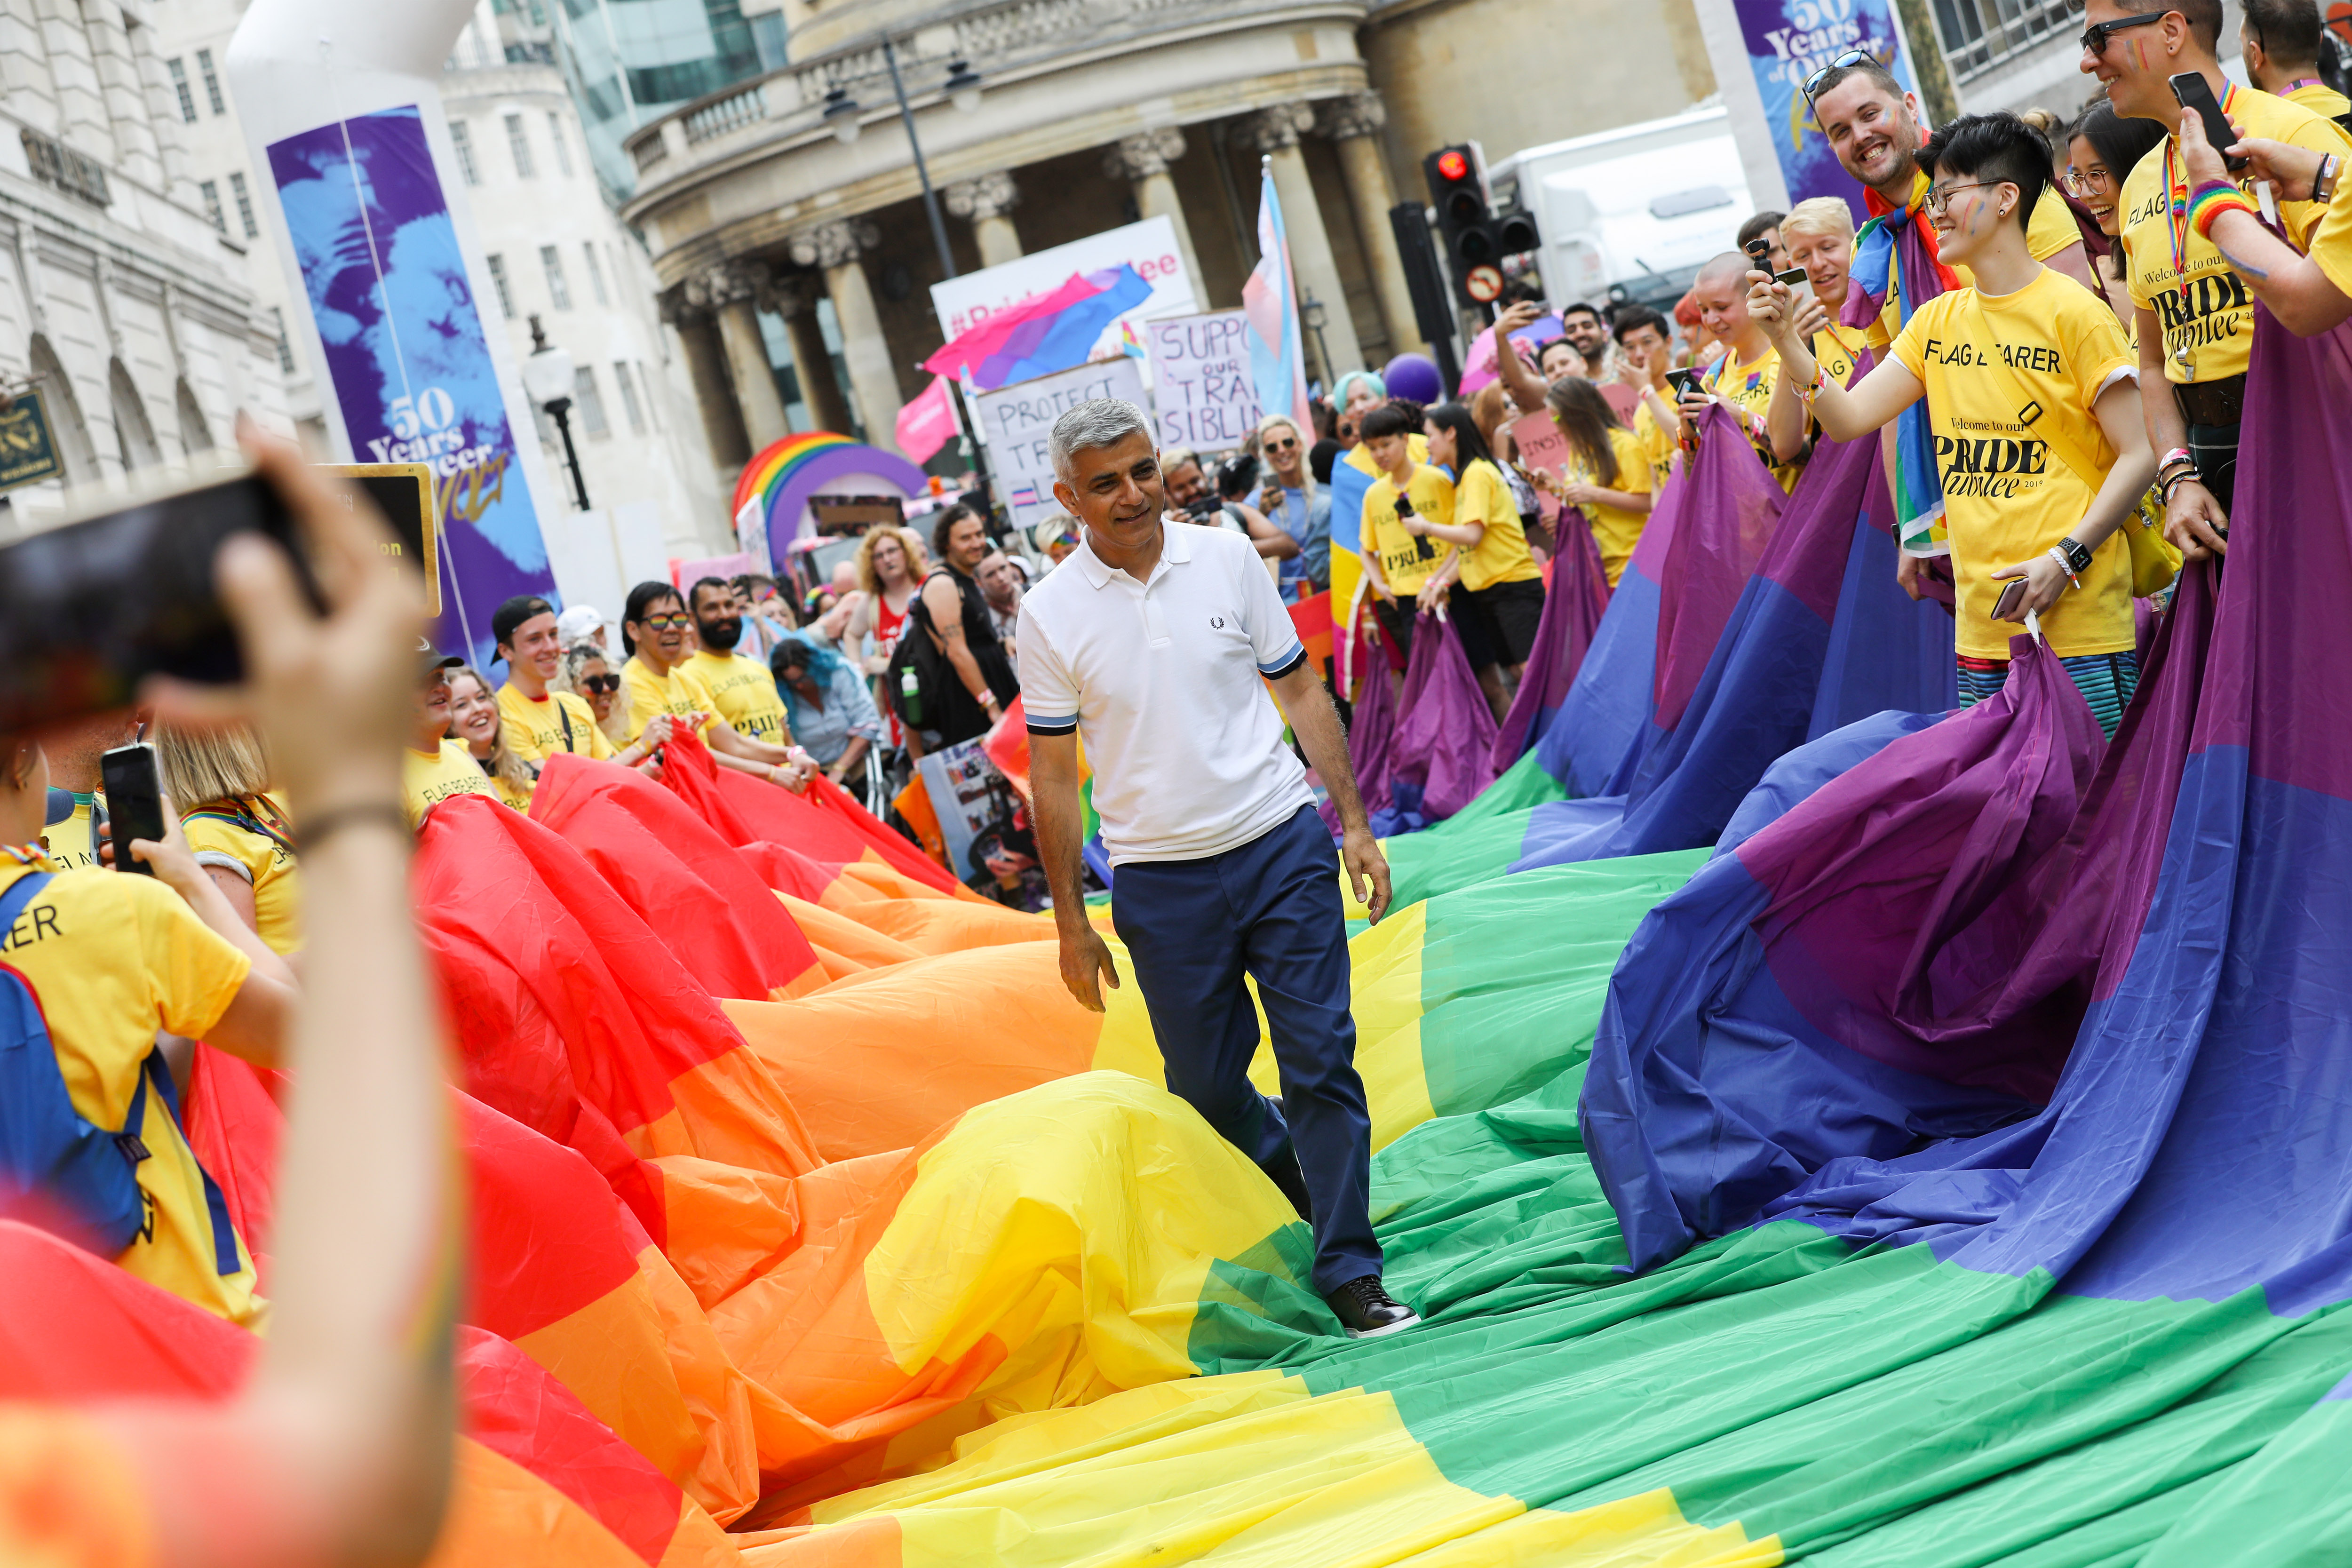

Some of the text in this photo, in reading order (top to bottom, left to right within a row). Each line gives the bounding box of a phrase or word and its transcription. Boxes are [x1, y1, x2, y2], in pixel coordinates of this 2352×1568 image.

[1764, 19, 1861, 62] Years
[1768, 63, 1787, 83] of
[2193, 260, 2203, 271] to
[1160, 317, 1251, 360] SUPP
[1202, 359, 1240, 376] OUR
[1178, 375, 1260, 405] TRA
[391, 387, 455, 440] 50
[997, 377, 1114, 436] PROTECT
[1992, 421, 2003, 431] to
[2006, 423, 2025, 432] our
[366, 426, 466, 463] Years
[1932, 435, 2048, 474] PRIDE
[2024, 480, 2043, 488] 2019
[422, 782, 451, 803] FLAG
